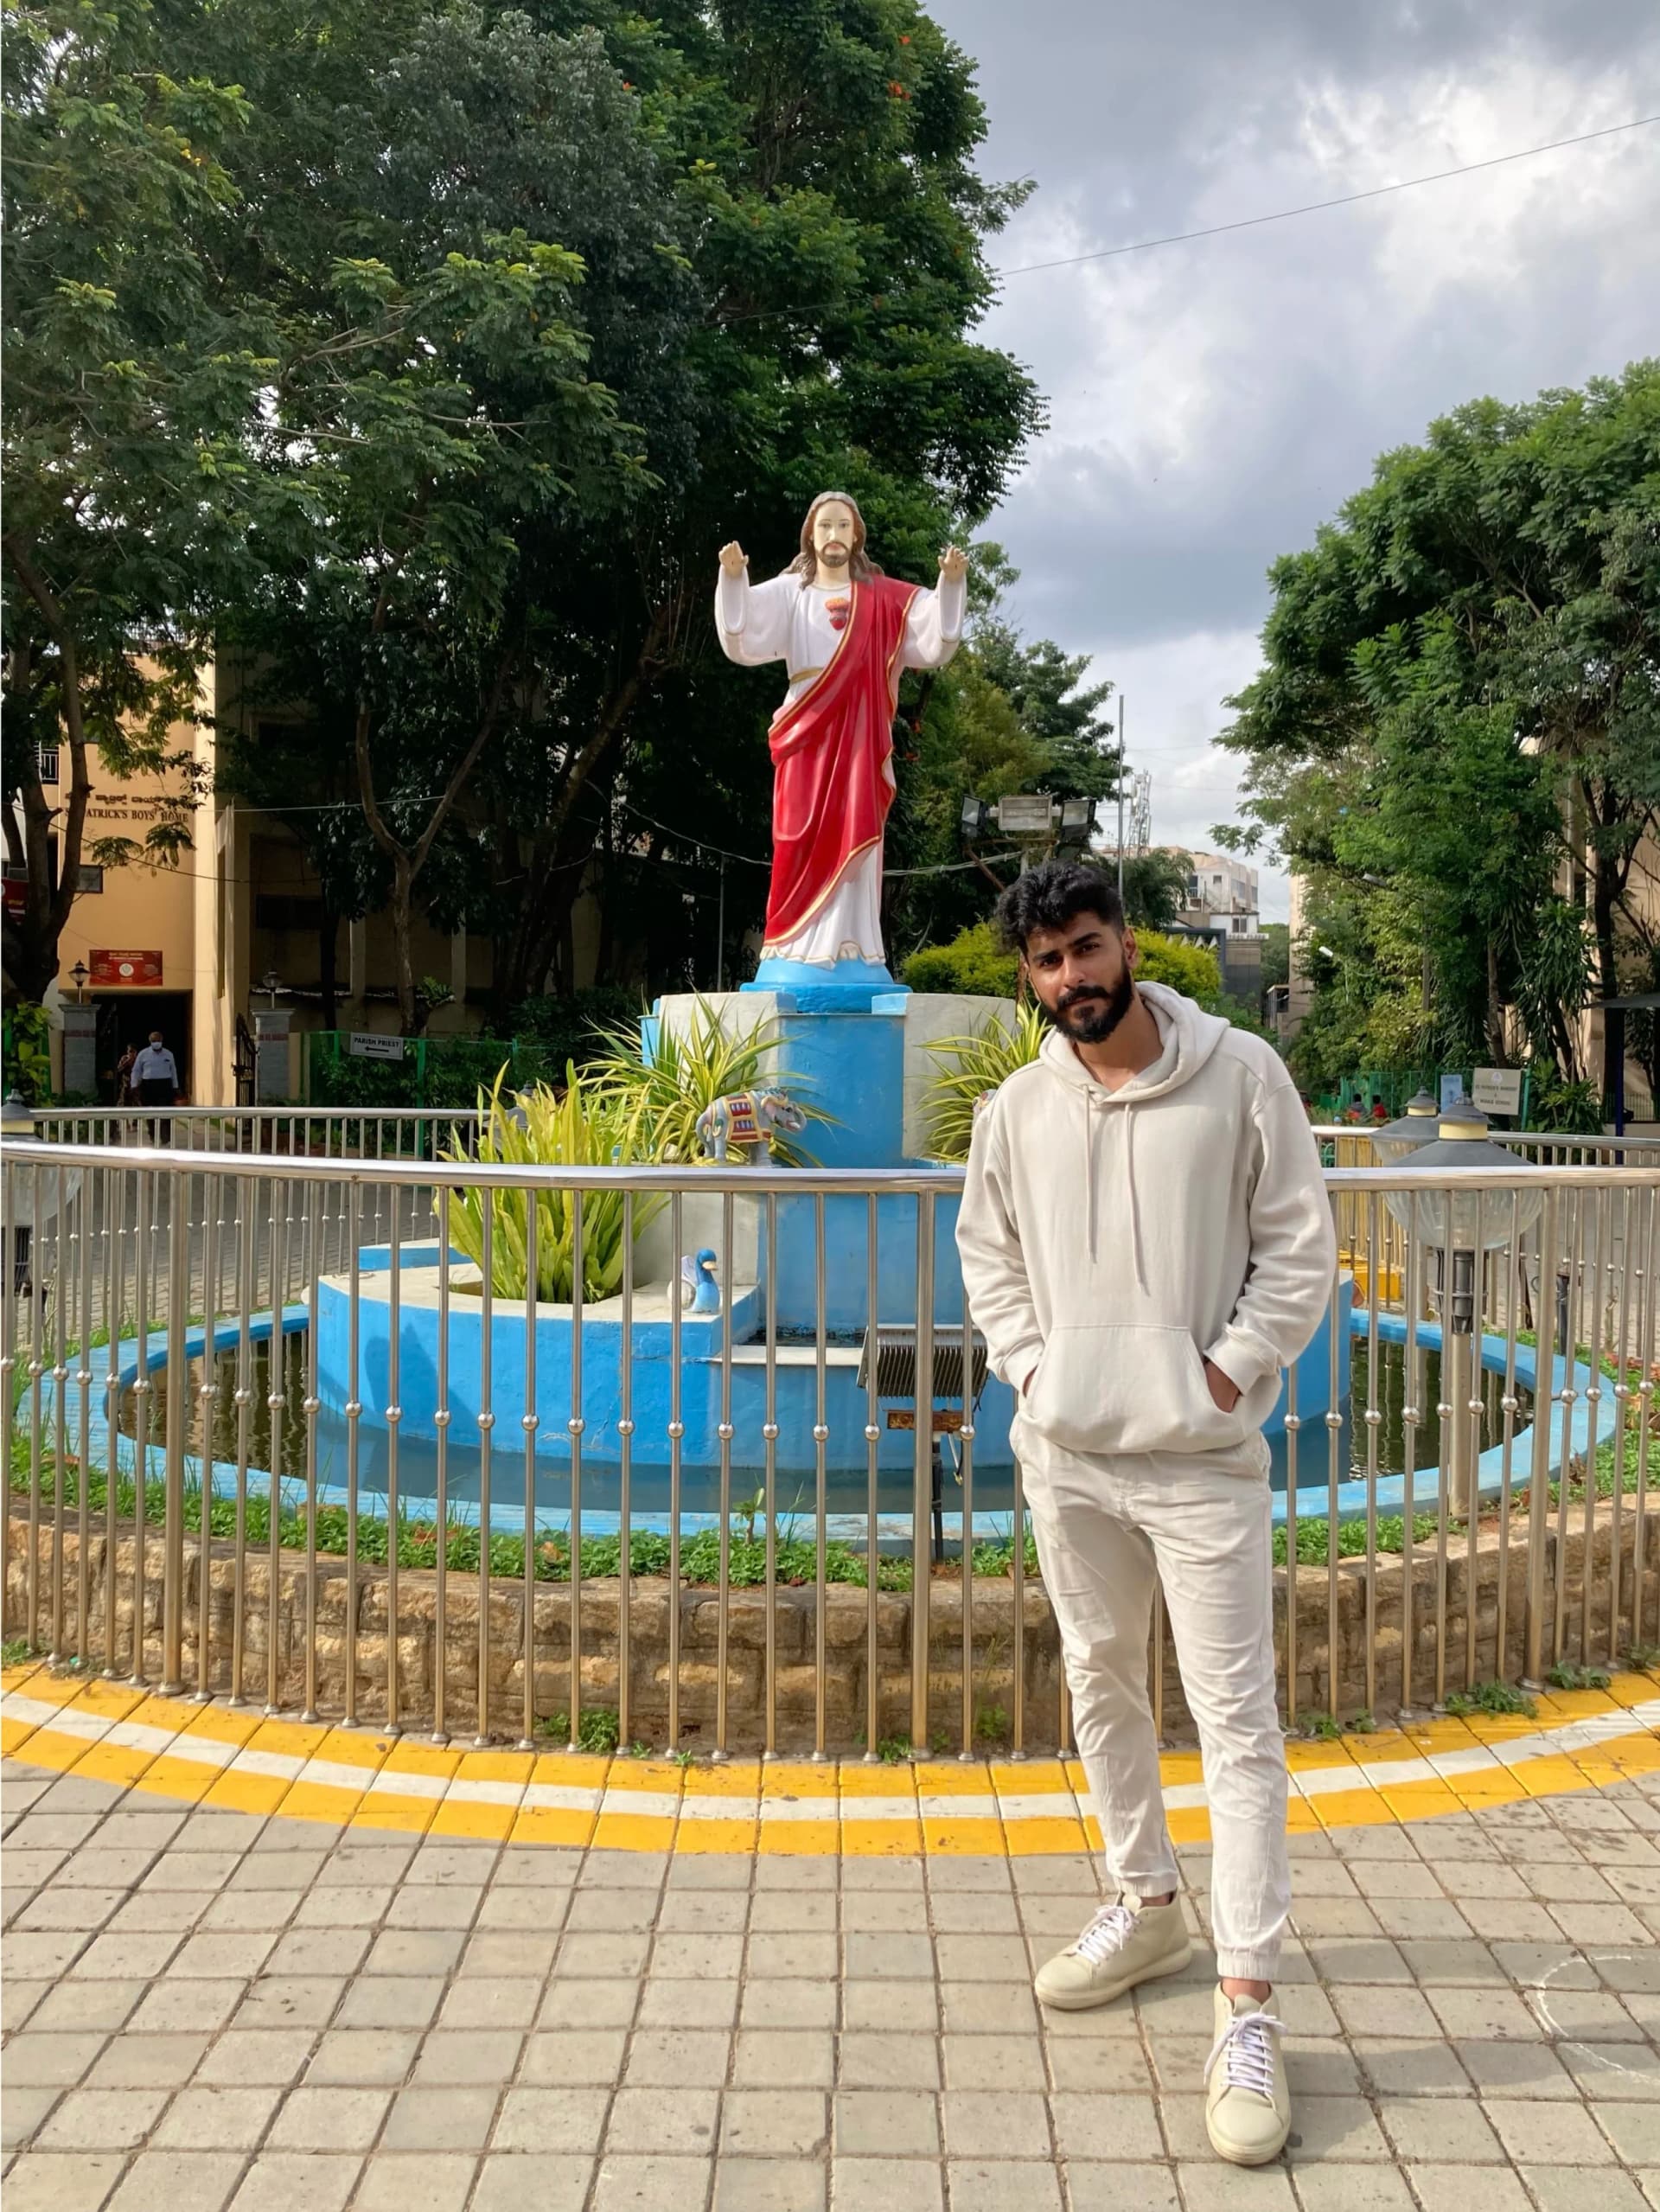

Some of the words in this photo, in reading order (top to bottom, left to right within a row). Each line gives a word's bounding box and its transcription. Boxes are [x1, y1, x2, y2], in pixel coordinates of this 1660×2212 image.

[86, 808, 128, 819] ATRICK'S
[354, 1037, 376, 1045] PARISH
[378, 1039, 399, 1048] PRIEST
